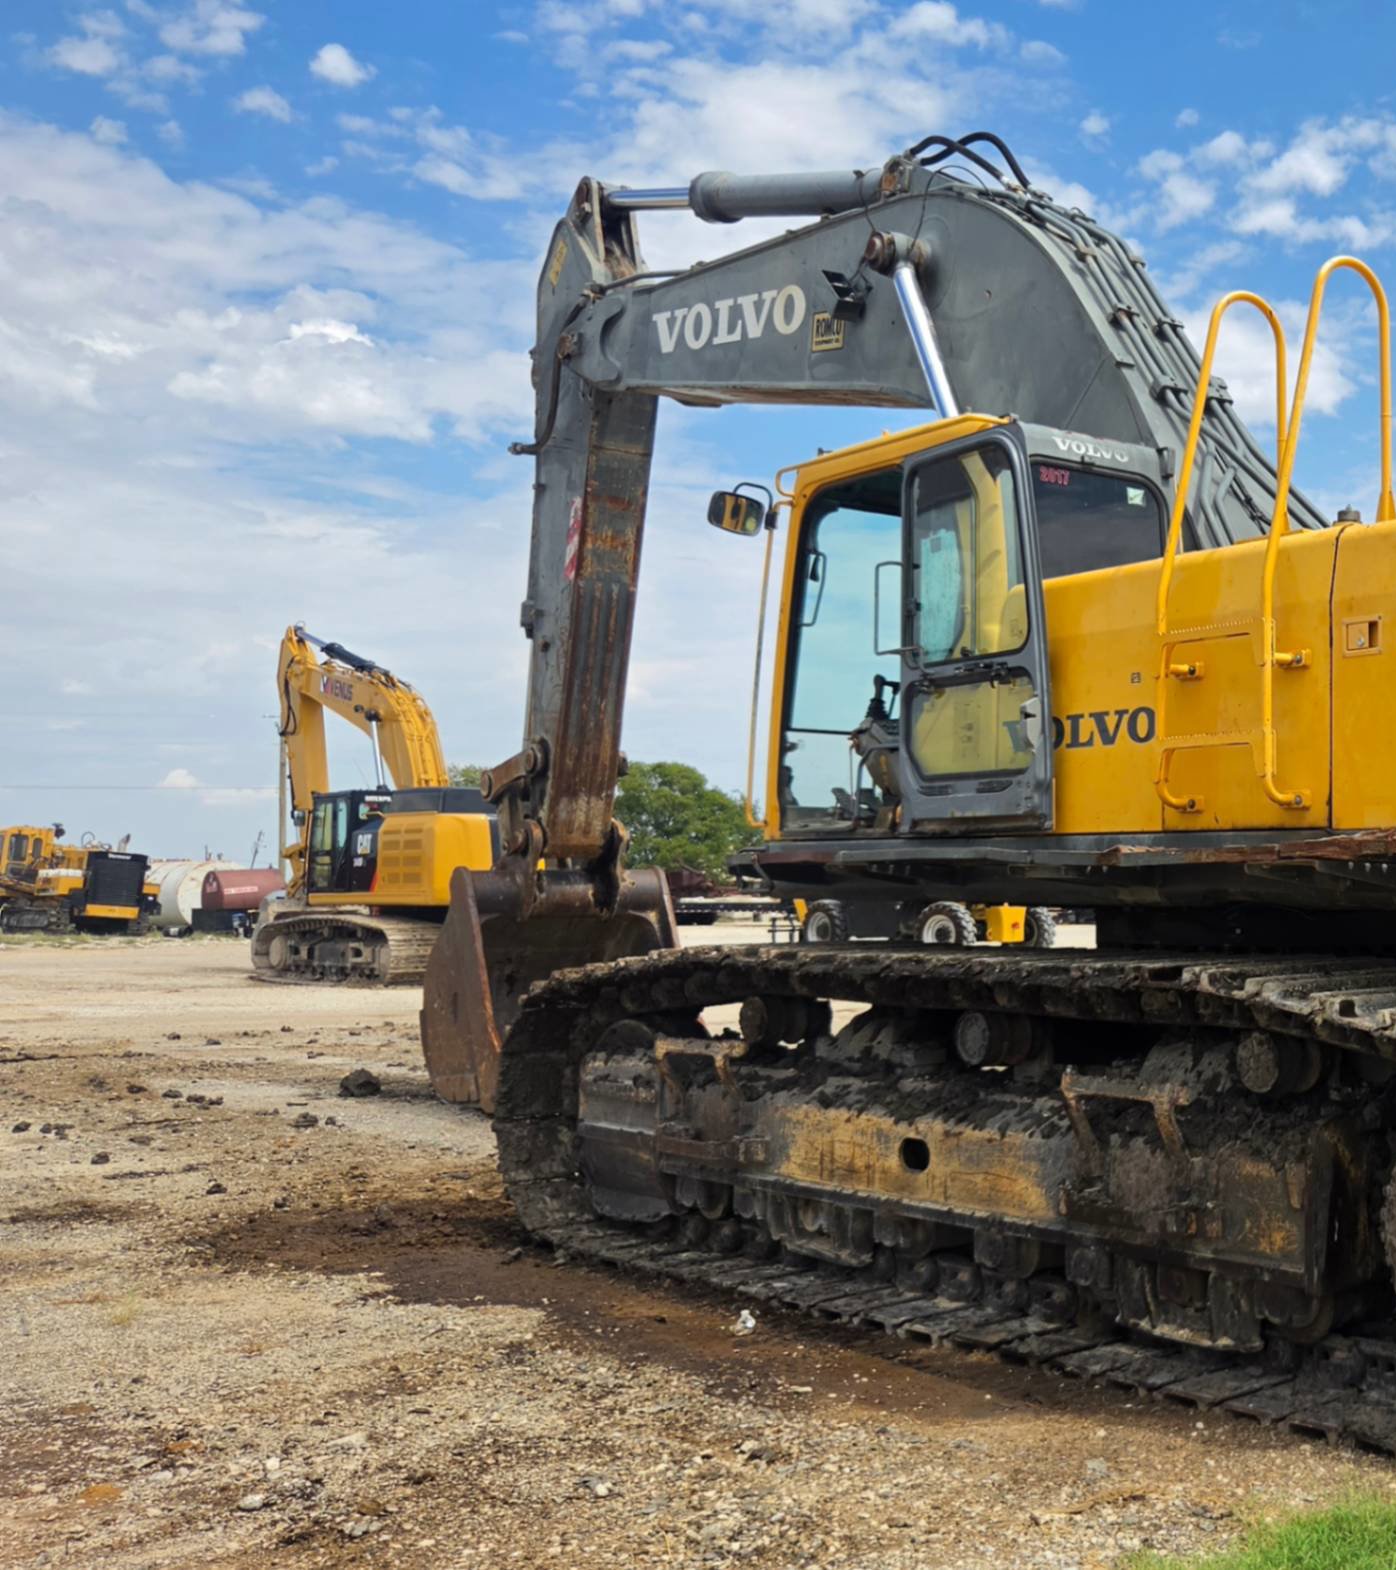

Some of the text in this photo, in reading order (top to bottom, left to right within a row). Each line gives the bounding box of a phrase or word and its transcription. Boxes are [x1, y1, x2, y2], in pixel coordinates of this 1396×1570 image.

[652, 284, 807, 354] VOLVO
[1052, 436, 1129, 463] VOLVO
[357, 833, 373, 855] CAT
